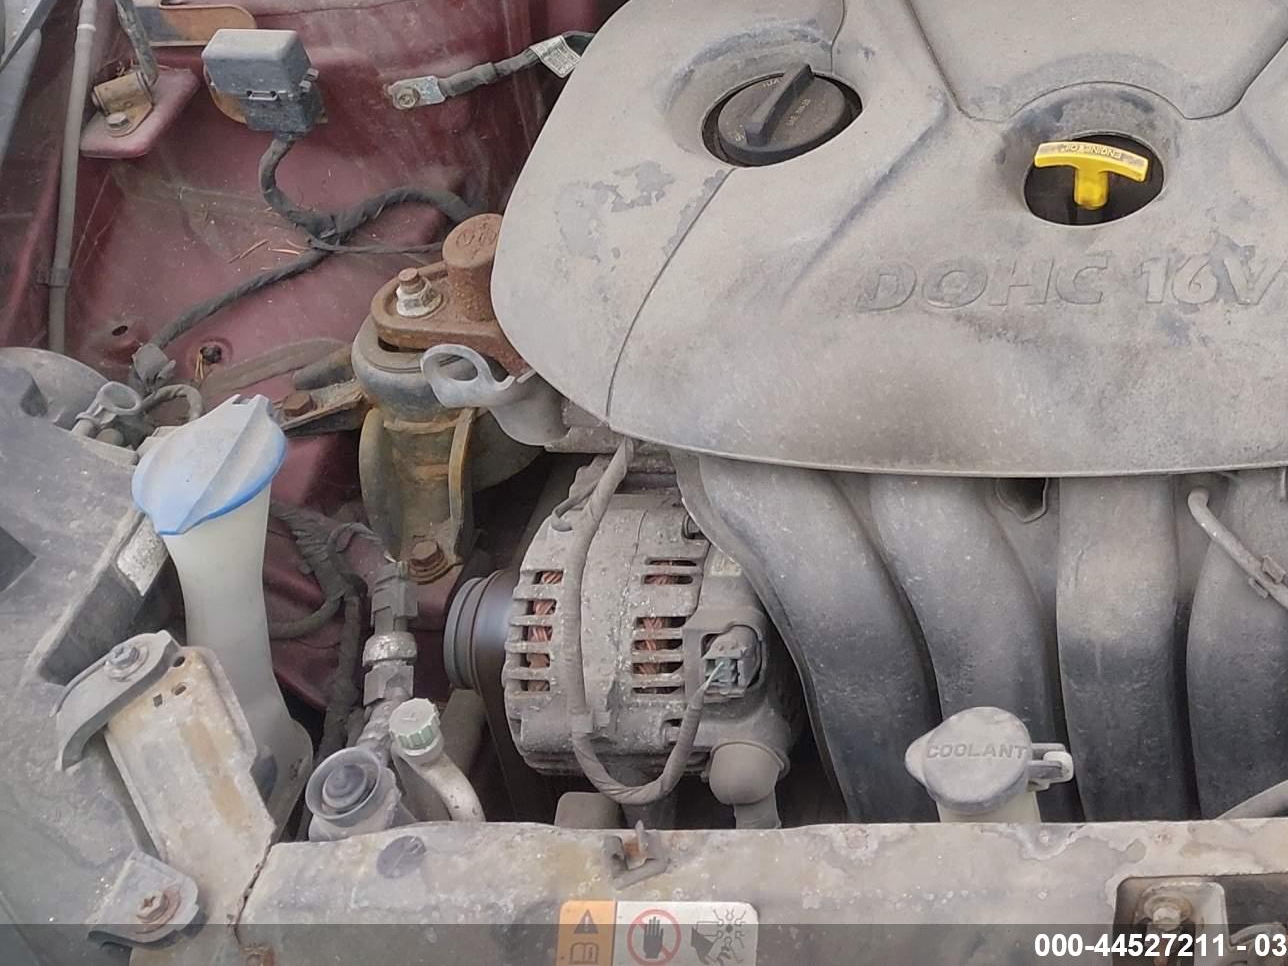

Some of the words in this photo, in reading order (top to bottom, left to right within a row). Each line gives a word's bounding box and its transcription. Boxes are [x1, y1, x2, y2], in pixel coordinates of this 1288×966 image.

[857, 255, 1111, 313] DOHC
[1140, 255, 1287, 307] 16V
[926, 743, 1028, 760] COOLANT
